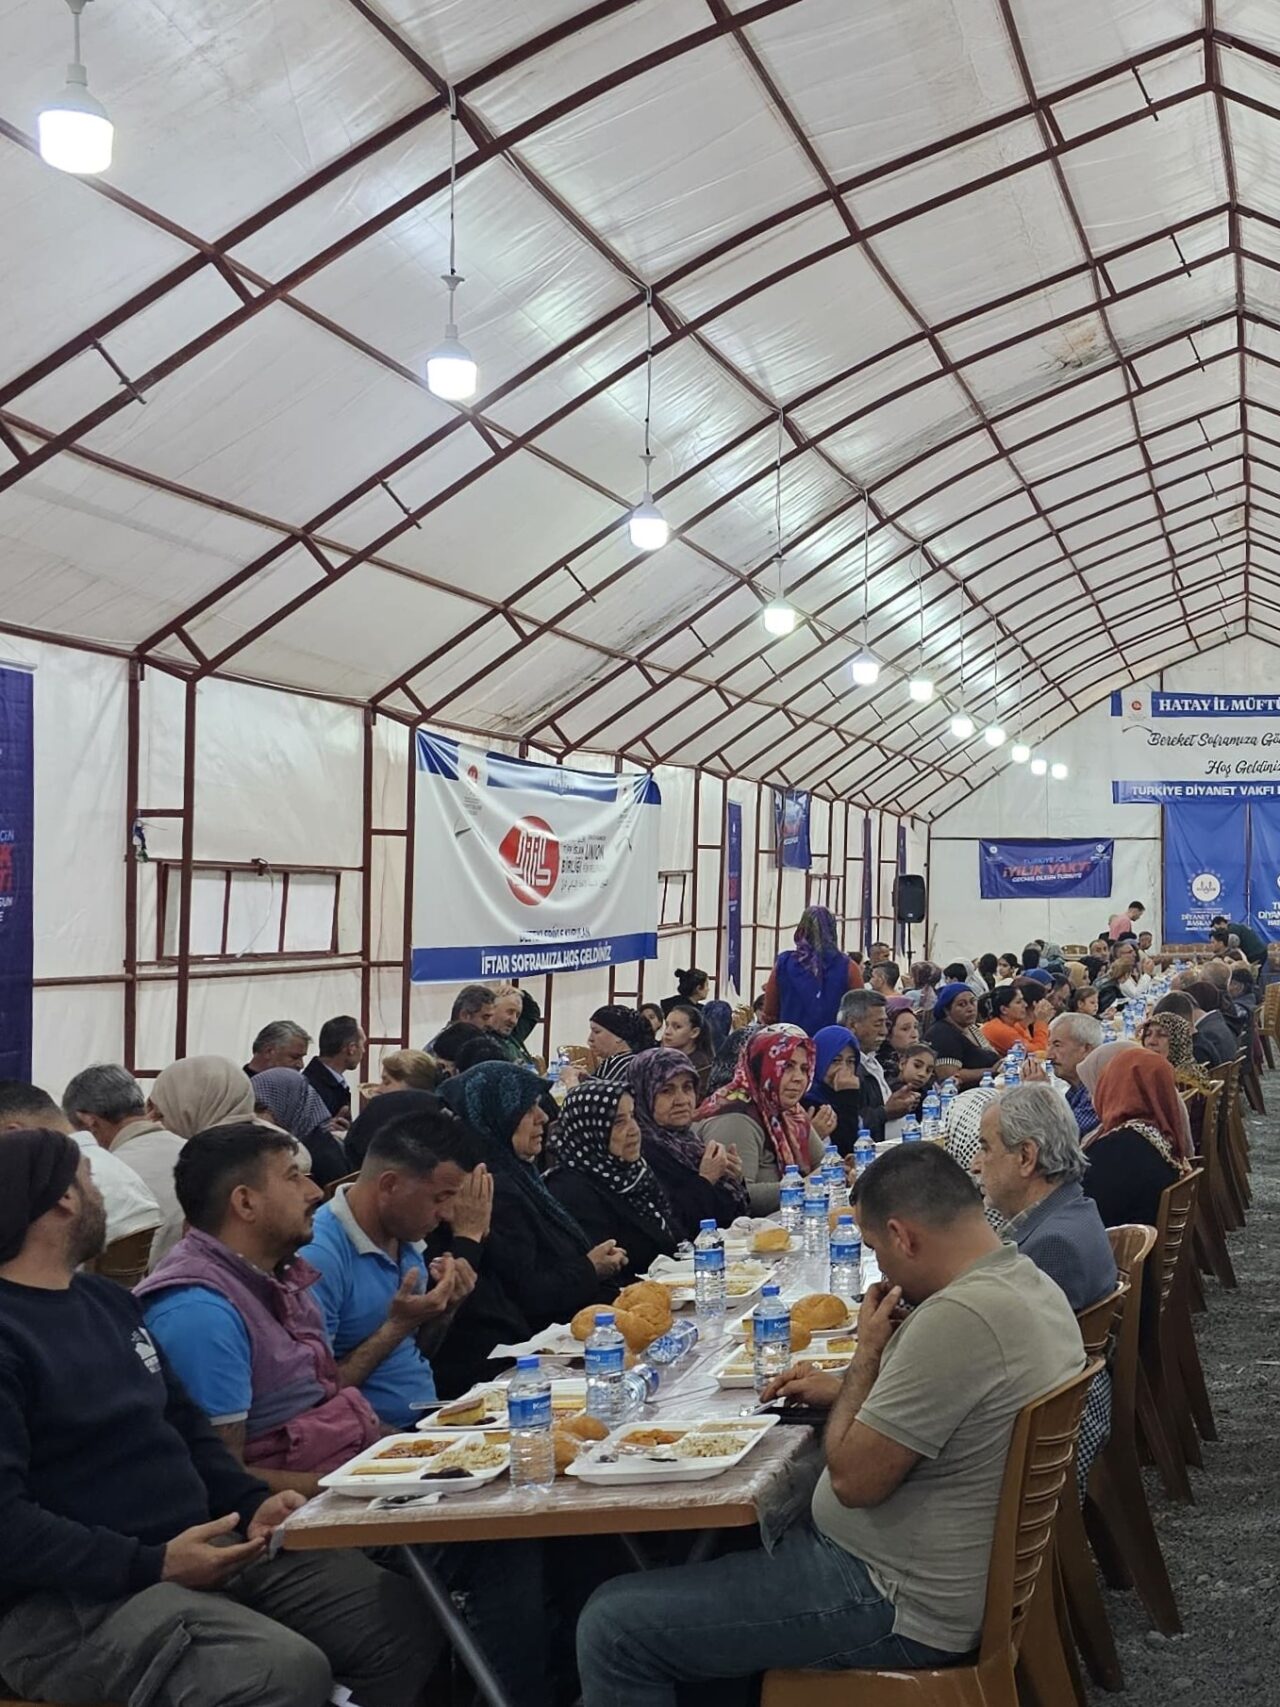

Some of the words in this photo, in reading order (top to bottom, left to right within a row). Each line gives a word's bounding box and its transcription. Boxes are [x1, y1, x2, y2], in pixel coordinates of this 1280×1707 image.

[1159, 698, 1211, 711] HATAY
[1214, 696, 1229, 711] İL
[1147, 732, 1197, 747] Bereket
[1197, 732, 1258, 747] Soframıza
[1205, 760, 1231, 777] Hoş
[1185, 783, 1236, 796] DİYANET
[1240, 784, 1274, 796] VAKFI
[481, 950, 509, 975] İFTAR
